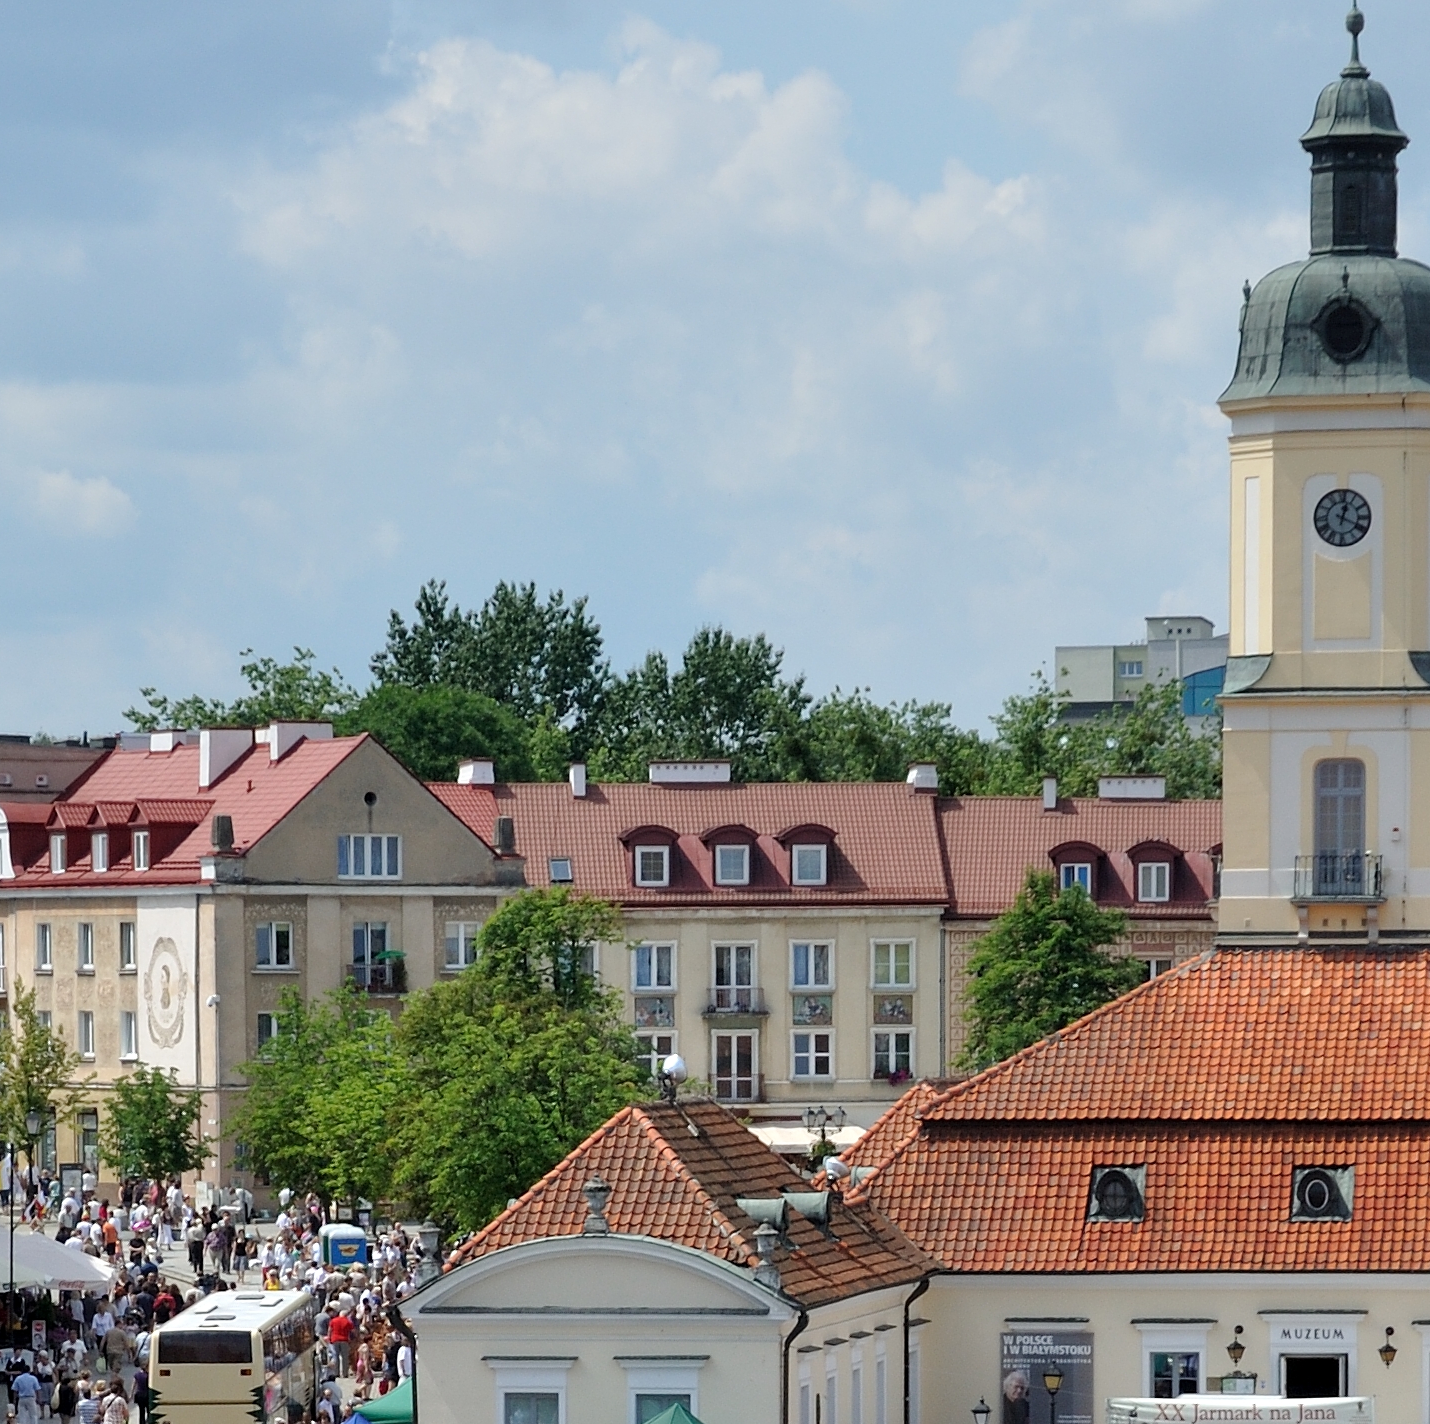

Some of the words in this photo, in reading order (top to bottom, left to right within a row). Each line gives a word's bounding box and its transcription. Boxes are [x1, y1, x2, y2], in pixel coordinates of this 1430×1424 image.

[1003, 1335, 1014, 1345] W
[1016, 1335, 1054, 1345] POLSCE
[1280, 1328, 1345, 1341] MUZEUM
[1010, 1345, 1020, 1355] W
[1022, 1345, 1091, 1356] BIAŁYMSTOKU
[1155, 1403, 1186, 1422] XX
[1192, 1403, 1264, 1424] Jarmark
[1269, 1407, 1291, 1421] na
[1296, 1403, 1337, 1424] Jana
